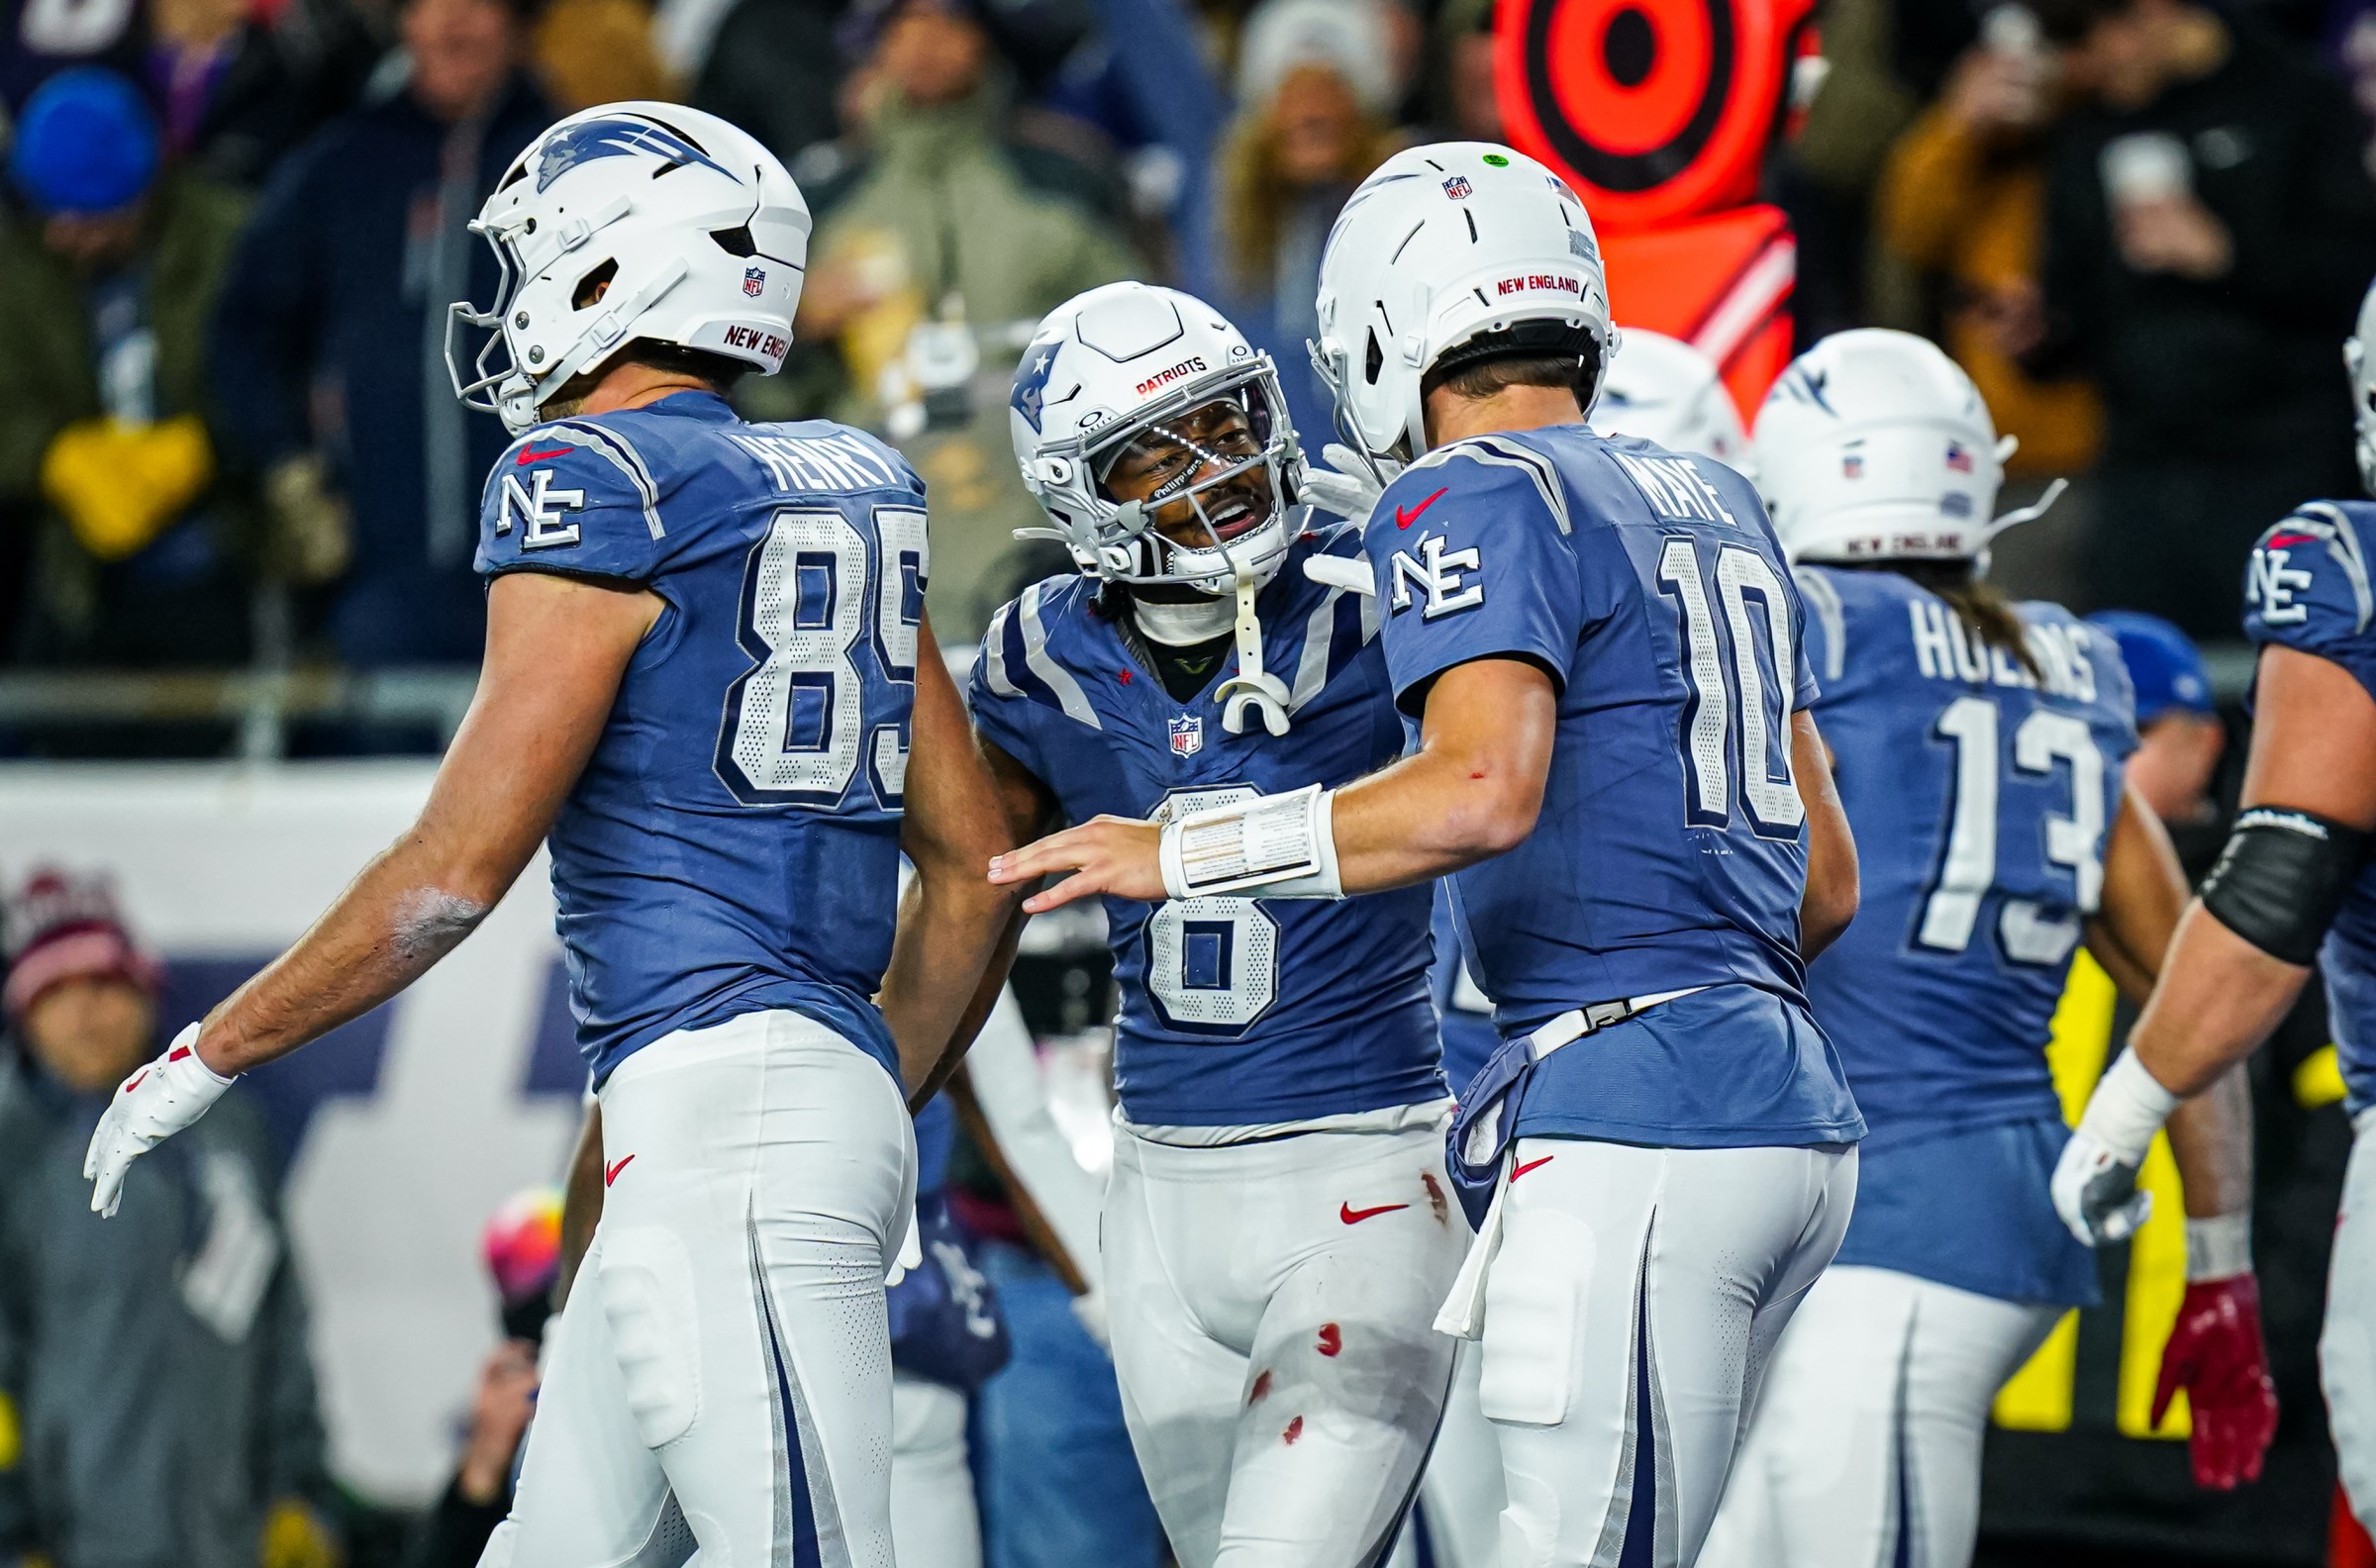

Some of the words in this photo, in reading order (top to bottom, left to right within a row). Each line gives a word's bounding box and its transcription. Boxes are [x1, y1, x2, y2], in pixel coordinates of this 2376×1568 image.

[1447, 184, 1471, 199] NFL
[744, 278, 761, 294] NFL
[1497, 277, 1525, 296] NEW
[1529, 275, 1579, 294] ENGLAND
[724, 325, 763, 350] NEW
[1136, 356, 1207, 395] PATRIOTS
[730, 434, 898, 493] HENRY
[1615, 450, 1736, 527] MAYE
[496, 468, 585, 552] NE
[1391, 536, 1485, 624] NE
[2245, 547, 2313, 624] NE
[712, 505, 930, 811] 85
[1654, 536, 1808, 842] 10
[1173, 734, 1198, 751] NFL
[1918, 697, 2106, 967] 13
